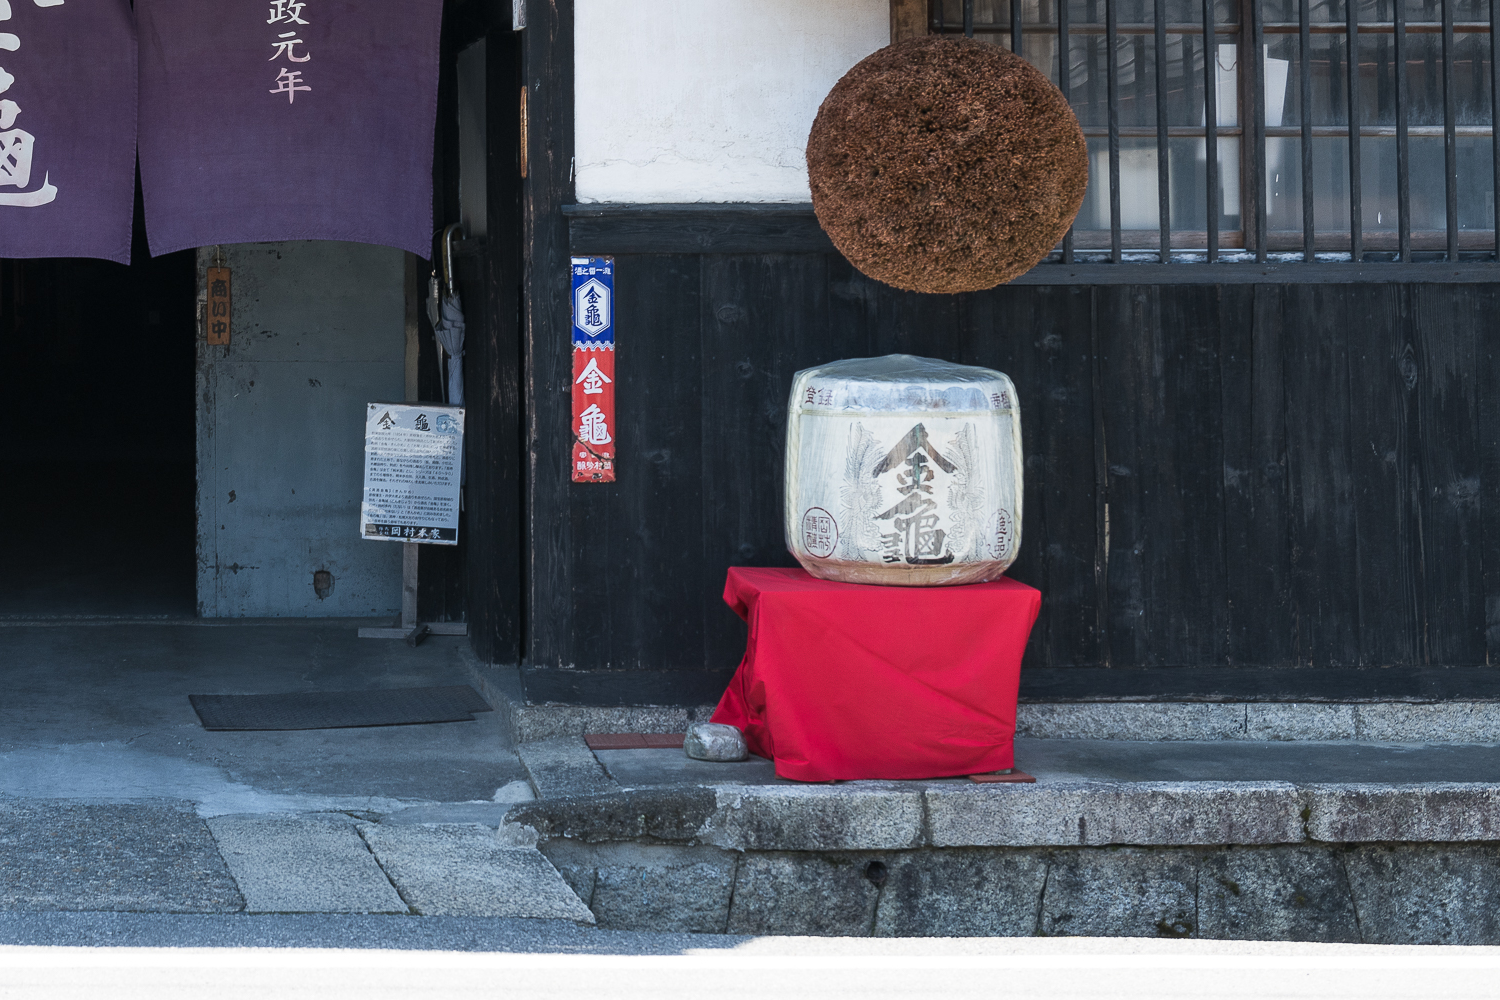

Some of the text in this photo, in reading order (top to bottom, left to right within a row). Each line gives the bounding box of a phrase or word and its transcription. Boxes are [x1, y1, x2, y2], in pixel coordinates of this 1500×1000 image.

[211, 278, 228, 340] 商い中
[391, 526, 441, 540] 岡村本家
